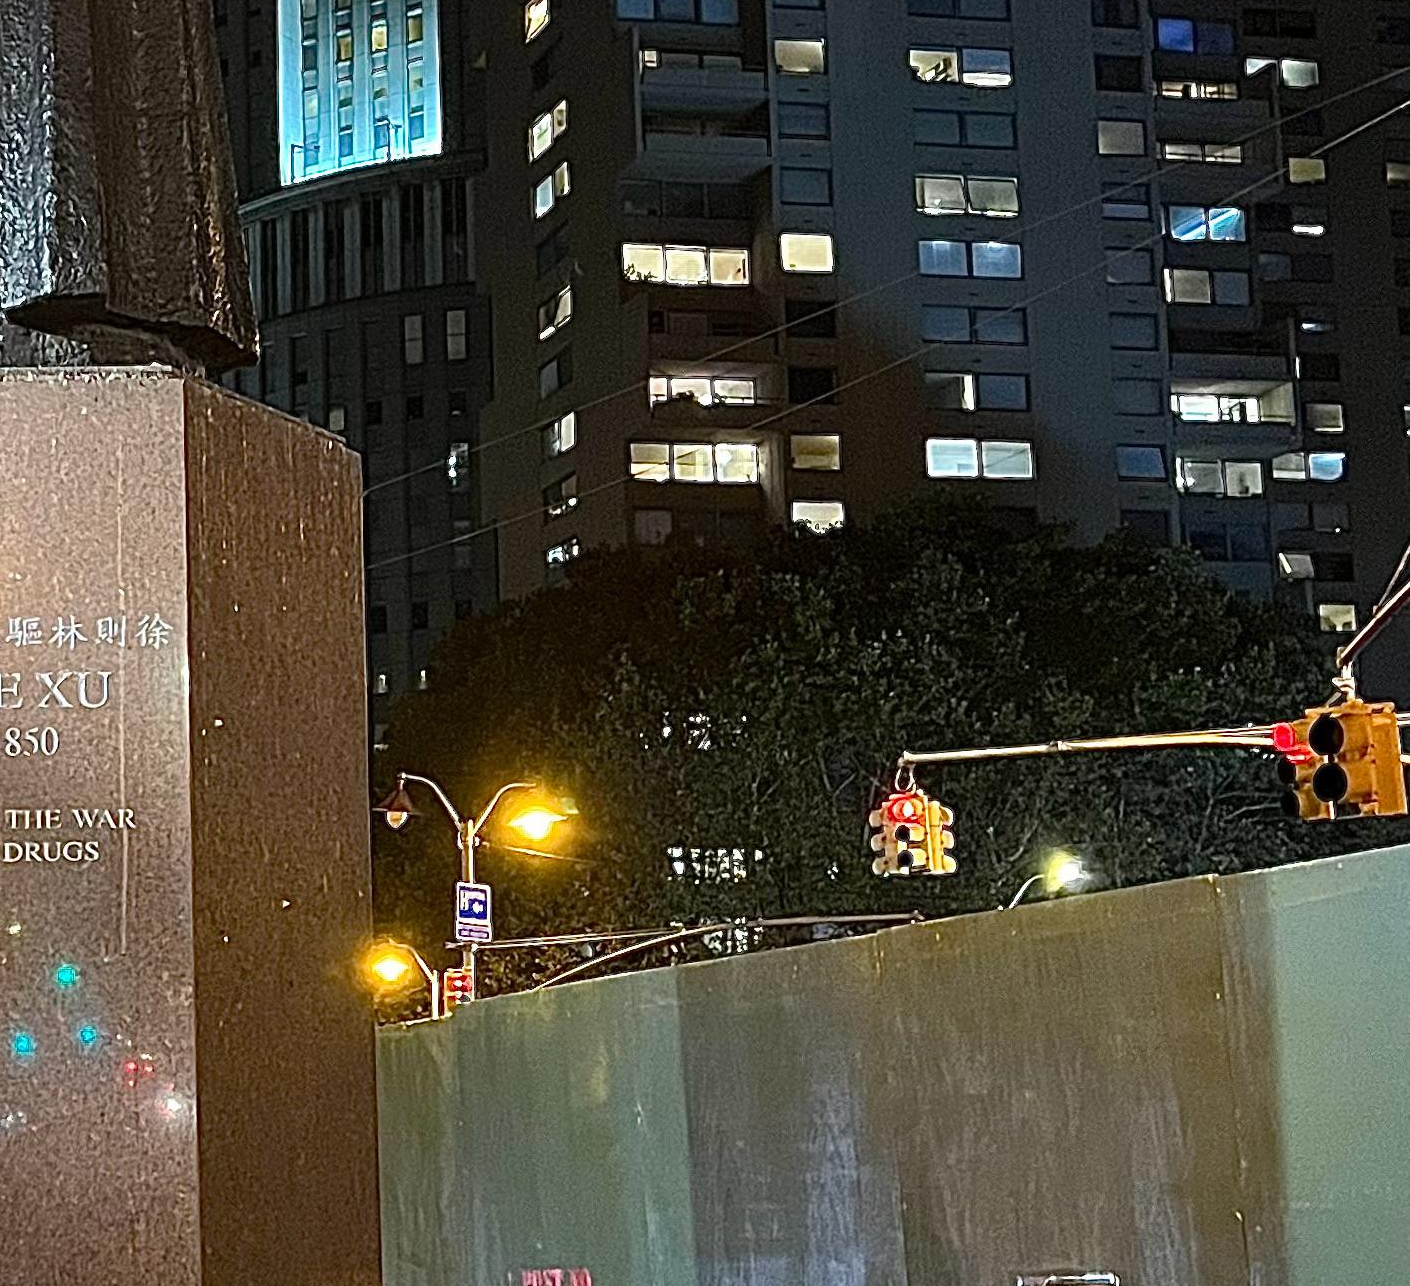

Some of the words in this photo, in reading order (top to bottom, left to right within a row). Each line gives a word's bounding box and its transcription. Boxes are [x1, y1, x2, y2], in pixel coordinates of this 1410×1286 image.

[35, 670, 112, 710] XU
[5, 808, 62, 830] THE
[71, 808, 137, 830] WAR
[2, 841, 100, 863] DRUGS
